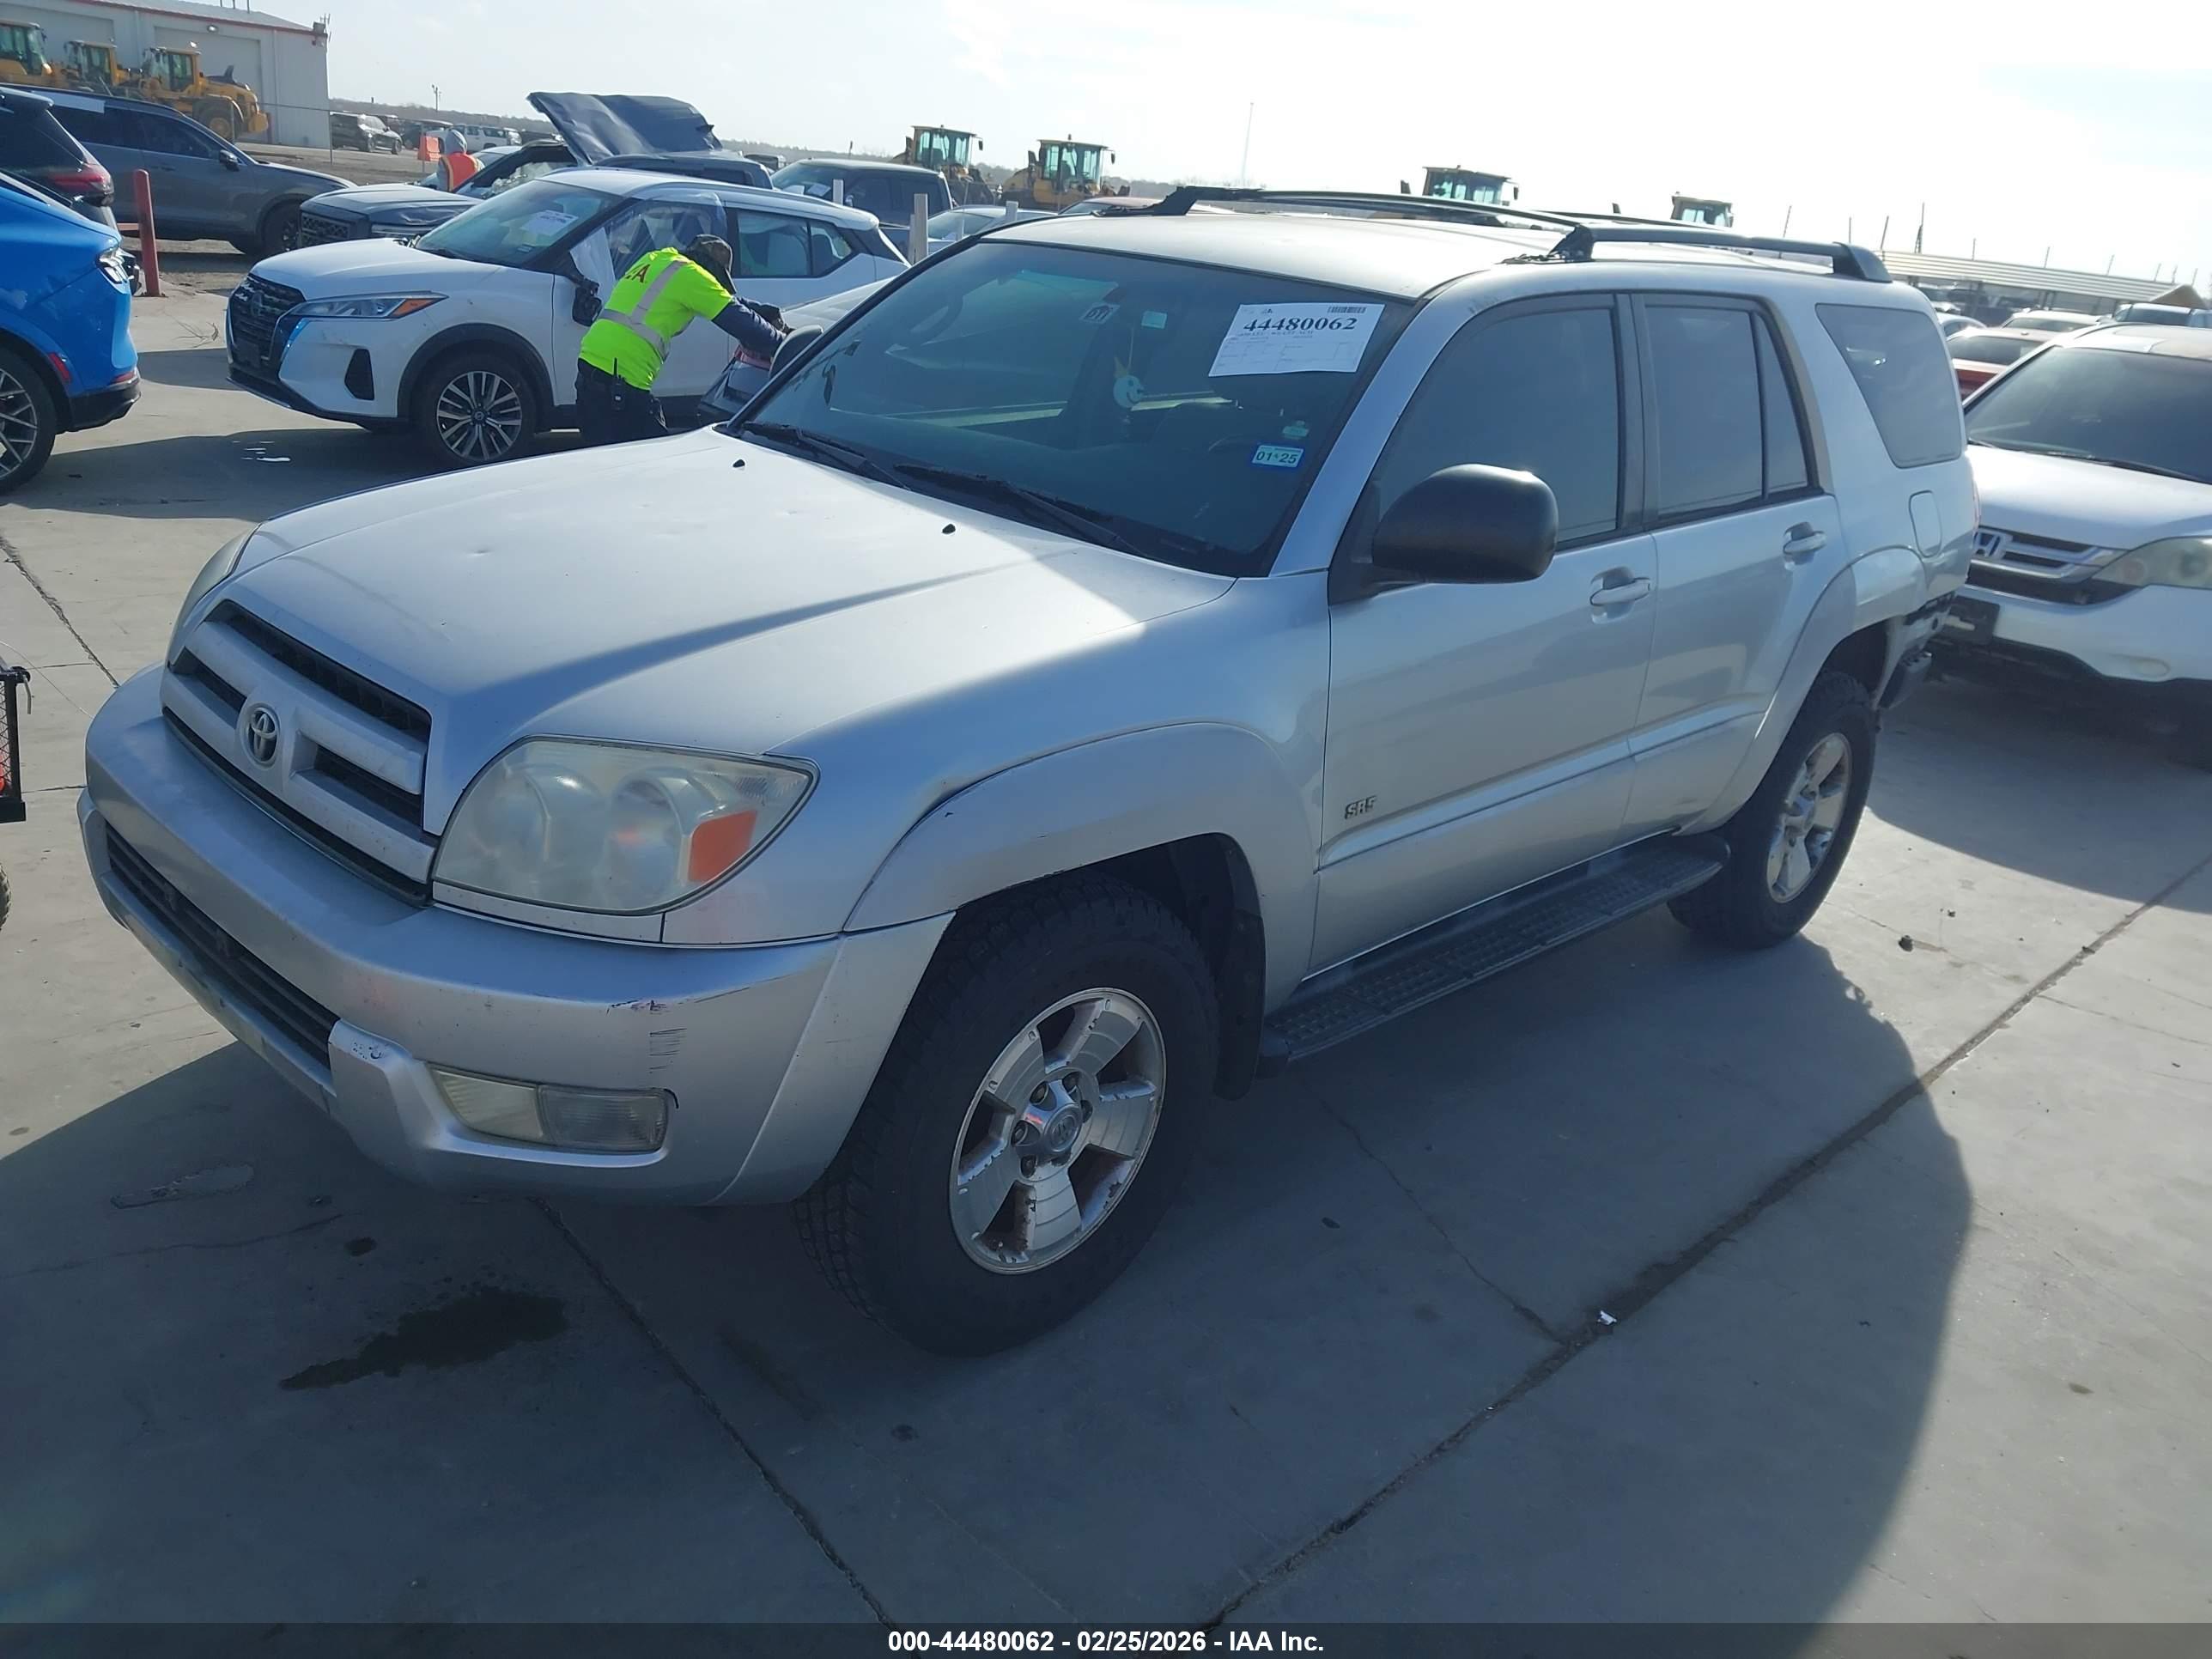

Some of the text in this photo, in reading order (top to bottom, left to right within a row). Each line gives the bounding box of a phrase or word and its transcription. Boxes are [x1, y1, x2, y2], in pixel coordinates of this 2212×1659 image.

[1243, 317, 1358, 332] 44480062
[1256, 451, 1298, 464] 01 25
